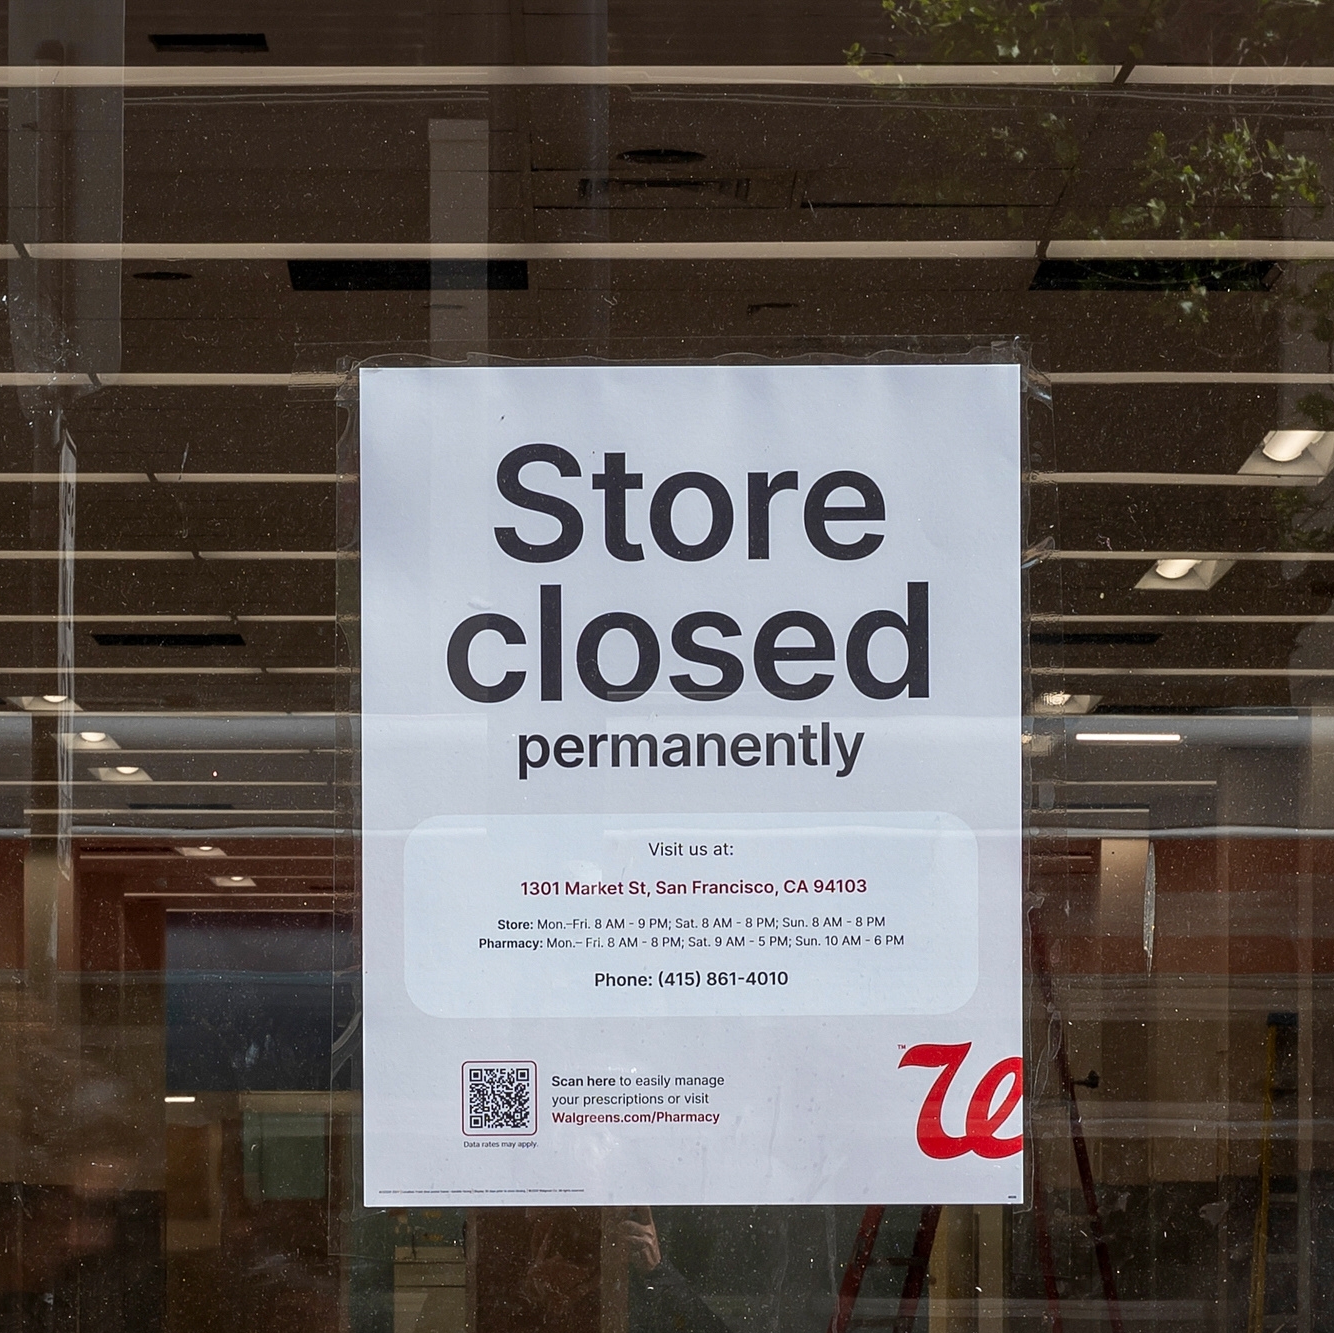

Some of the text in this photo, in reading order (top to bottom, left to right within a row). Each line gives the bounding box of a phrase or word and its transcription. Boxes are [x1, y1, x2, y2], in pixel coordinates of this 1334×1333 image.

[493, 443, 886, 563] Store
[446, 582, 930, 703] closed
[518, 722, 865, 779] permanently
[648, 842, 734, 857] Visit us at:
[520, 878, 868, 898] 1301 Market St, San Francisco, CA 94103
[497, 919, 534, 930] Store:
[594, 918, 603, 930] 8
[605, 918, 625, 930] AM
[637, 917, 646, 929] 9
[649, 917, 672, 931] PM;
[675, 917, 699, 929] Sat.
[701, 917, 710, 929] 8
[712, 917, 733, 929] AM
[744, 917, 753, 929] 8
[756, 917, 779, 930] PM;
[782, 916, 809, 928] Sun.
[811, 916, 820, 928] 8
[822, 916, 843, 928] AM
[855, 916, 864, 928] 8
[866, 916, 886, 927] PM
[478, 938, 544, 951] Pharmacy:
[585, 936, 604, 948] Fri.
[607, 936, 616, 948] 8
[618, 936, 638, 948] AM
[650, 936, 659, 948] 8
[662, 936, 685, 950] PM;
[688, 936, 711, 948] Sat.
[714, 936, 723, 948] 9
[725, 935, 746, 947] AM
[758, 935, 766, 947] 5
[769, 935, 792, 949] PM;
[795, 935, 821, 947] Sun.
[824, 935, 839, 947] 10
[841, 934, 862, 946] AM
[874, 934, 882, 946] 6
[885, 934, 905, 946] PM
[594, 970, 789, 988] Phone: (415) 861-4010
[551, 1074, 725, 1089] Scan here to easily manage
[551, 1092, 710, 1108] your prescriptions or visit
[551, 1110, 721, 1126] Walgreens.com/Pharmacy
[463, 1140, 539, 1149] Data rates may apply.
